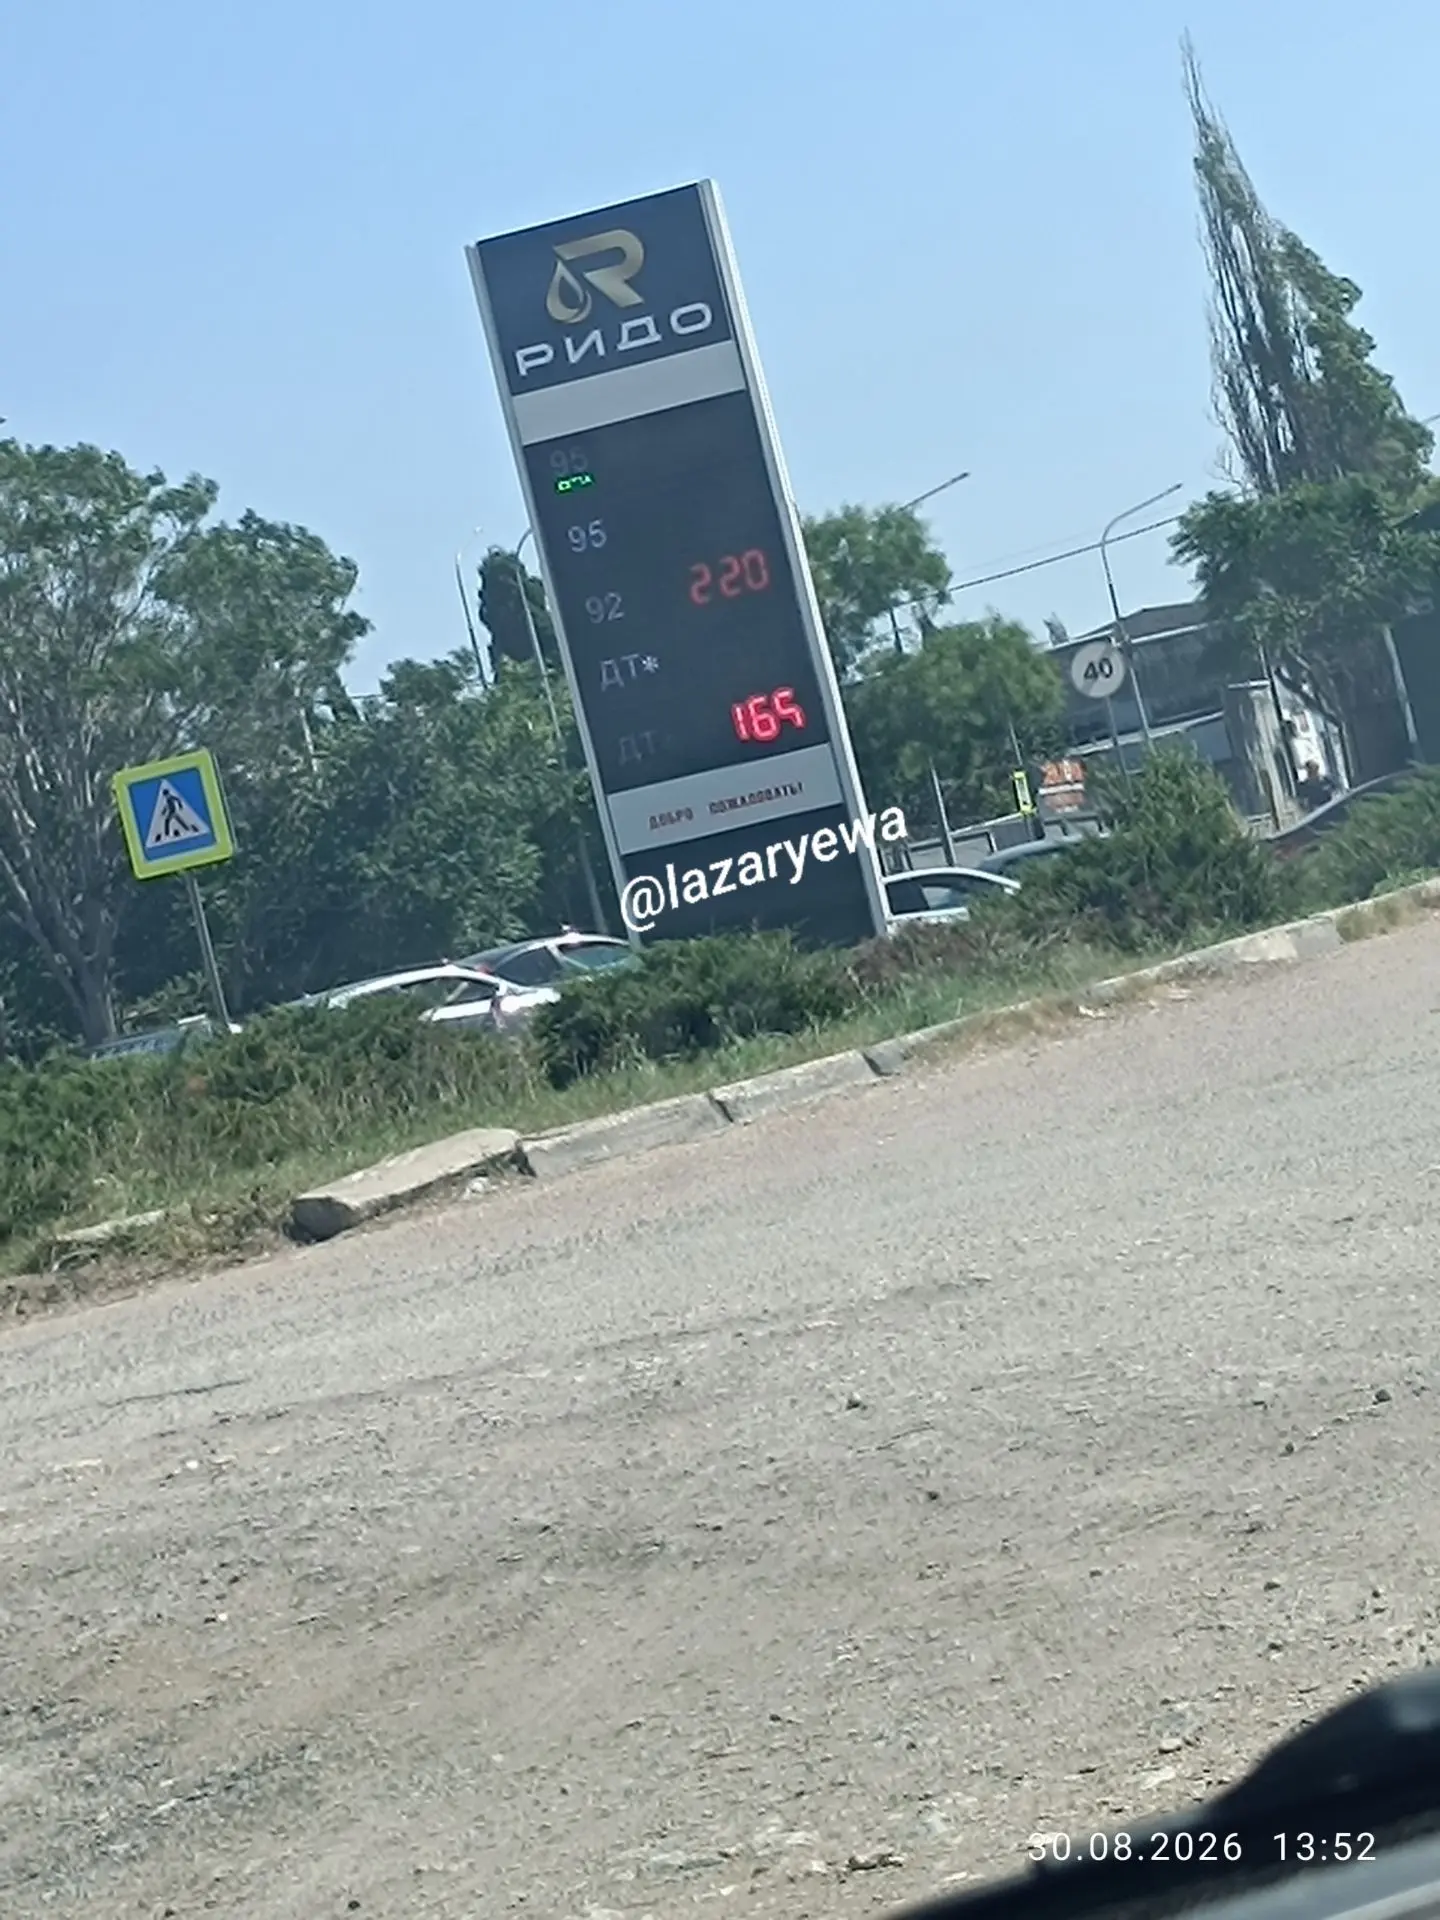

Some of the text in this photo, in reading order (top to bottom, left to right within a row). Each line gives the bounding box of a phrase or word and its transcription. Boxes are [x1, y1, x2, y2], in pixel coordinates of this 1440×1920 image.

[514, 301, 713, 377] РИДО
[567, 518, 607, 553] 95
[585, 548, 770, 624] 92 220
[1083, 658, 1113, 679] 40
[730, 687, 806, 743] 165
